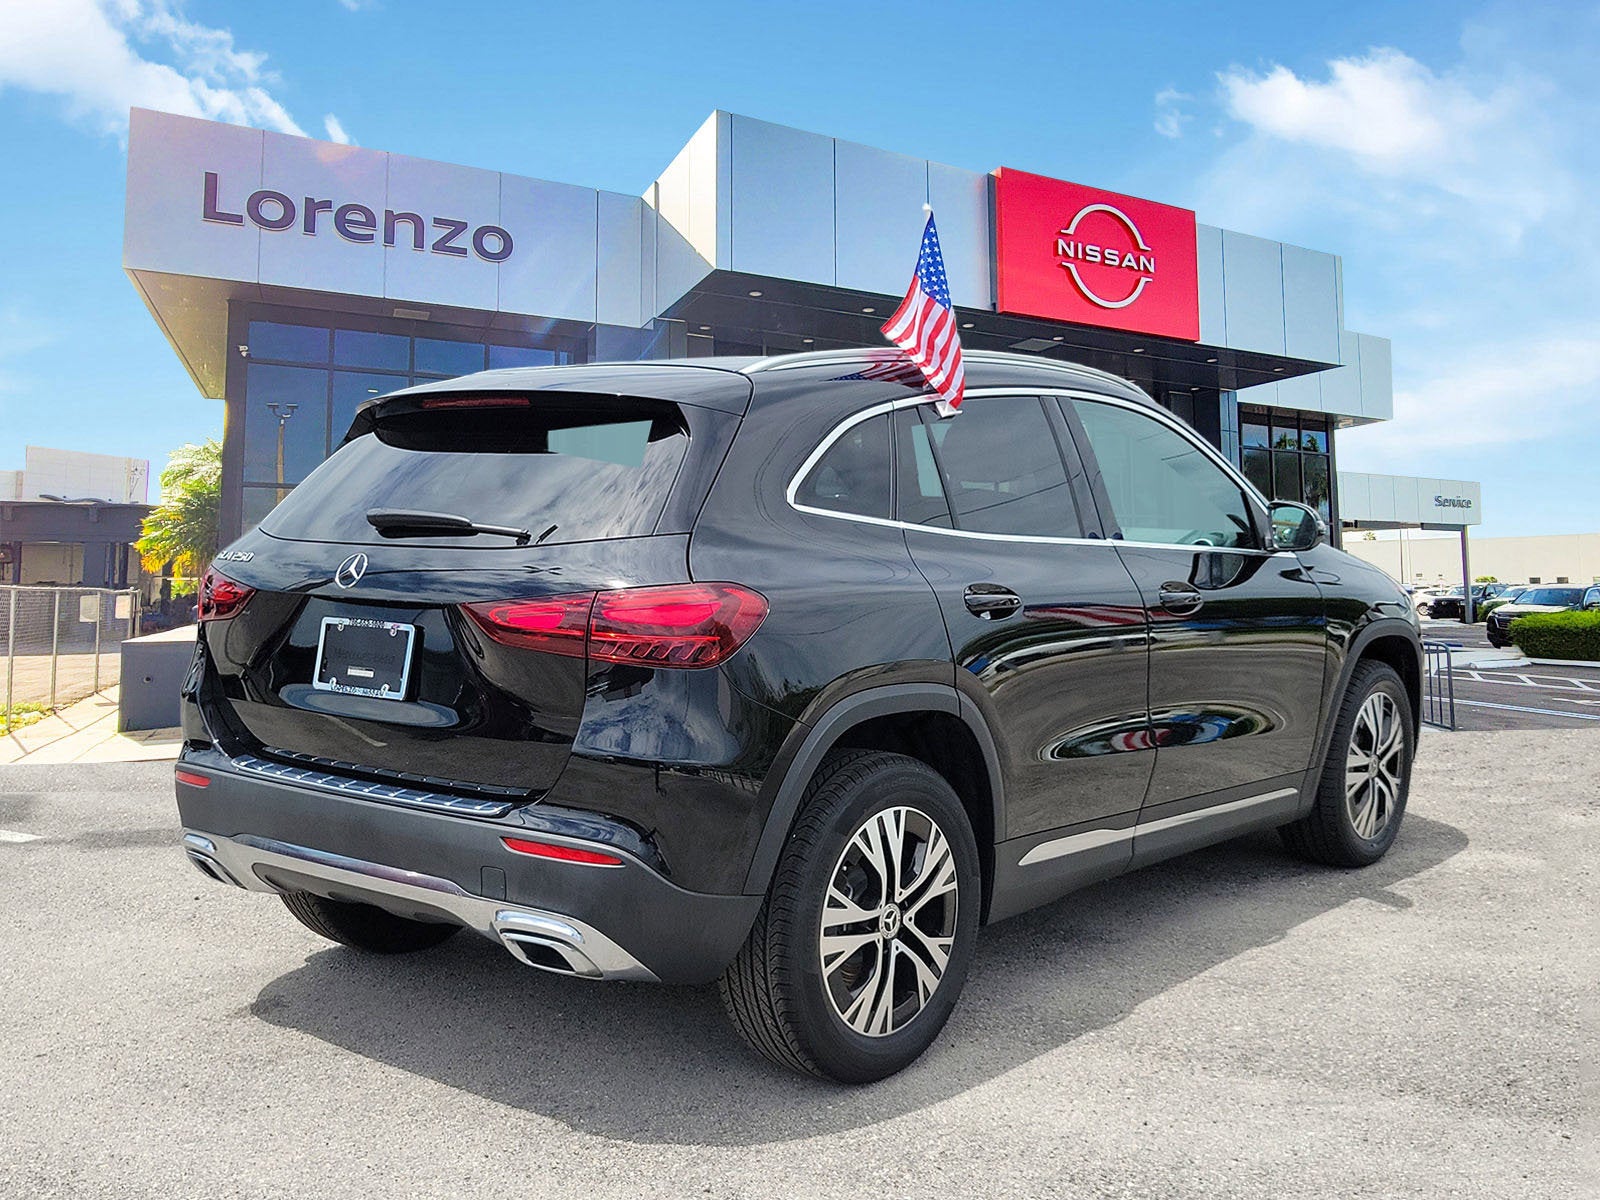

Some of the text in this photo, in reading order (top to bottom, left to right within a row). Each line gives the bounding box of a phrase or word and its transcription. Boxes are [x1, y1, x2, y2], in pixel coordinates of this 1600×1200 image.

[203, 171, 514, 262] Lorenzo
[1058, 238, 1155, 273] NISSAN
[1434, 495, 1472, 508] Service
